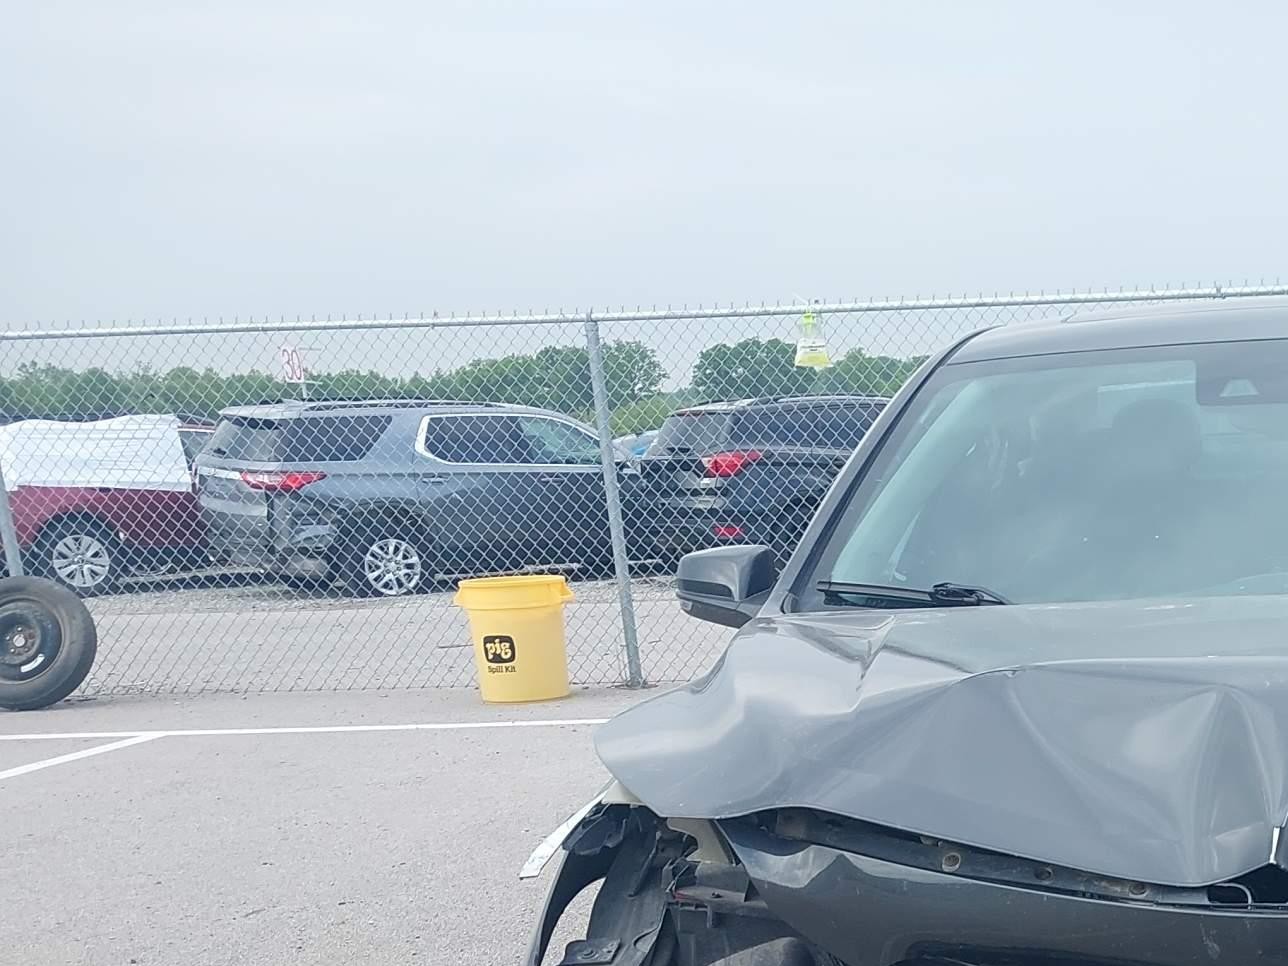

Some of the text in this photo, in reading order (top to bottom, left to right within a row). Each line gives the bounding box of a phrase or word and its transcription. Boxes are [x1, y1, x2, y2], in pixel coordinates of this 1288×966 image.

[282, 349, 302, 380] 30
[485, 638, 512, 660] pig
[488, 666, 503, 674] Spill
